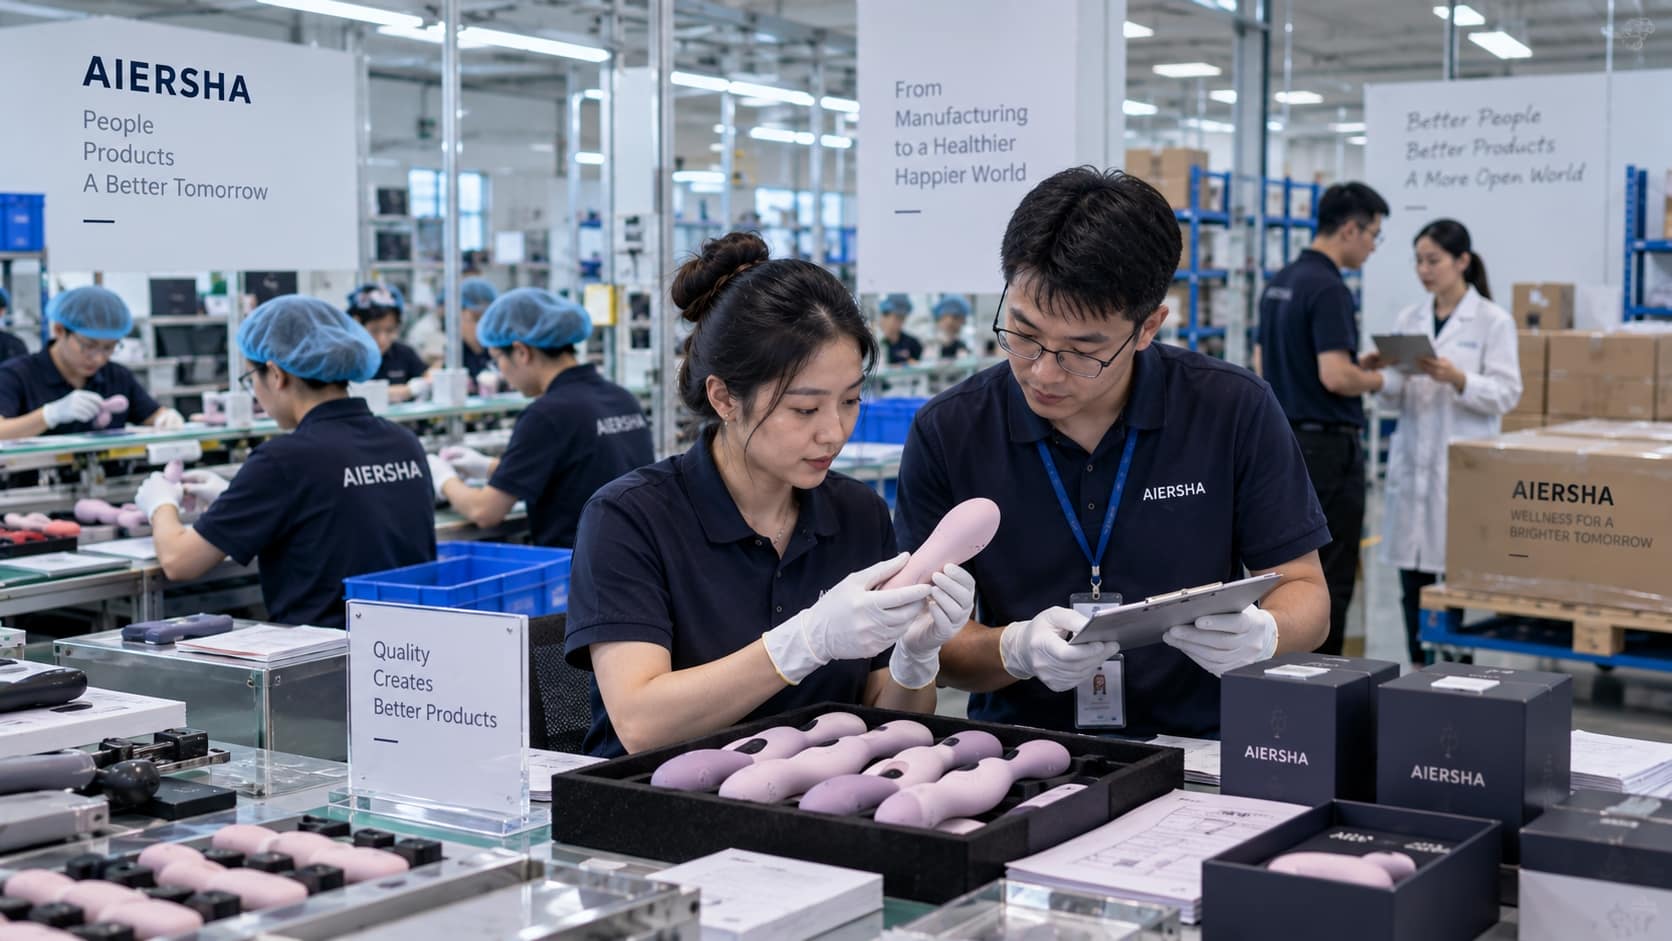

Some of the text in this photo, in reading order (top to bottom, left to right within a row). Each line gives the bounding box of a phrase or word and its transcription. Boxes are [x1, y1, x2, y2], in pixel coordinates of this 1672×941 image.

[82, 55, 251, 104] AIERSHA
[895, 80, 942, 99] From
[83, 109, 154, 138] People
[895, 104, 1028, 128] Manufacturing
[1405, 104, 1542, 132] Better People
[83, 141, 175, 166] Products
[894, 133, 1016, 157] to a Healthier
[1405, 135, 1557, 161] Better Products
[83, 173, 269, 201] A Better Tomorrow
[895, 162, 1027, 190] Happier World
[1404, 161, 1587, 192] A More Open World
[343, 460, 423, 488] AIERSHA
[1143, 481, 1206, 501] AIERSHA
[1512, 480, 1615, 506] AIERSHA
[1511, 508, 1614, 528] WELLNESS FOR A
[1510, 525, 1653, 549] BRIGHTER TOMORROW
[373, 640, 430, 667] Quality
[373, 668, 433, 692] Creates
[374, 697, 498, 728] Better Products
[1244, 745, 1309, 766] AIERSHA
[1410, 764, 1486, 788] AIERSHA
